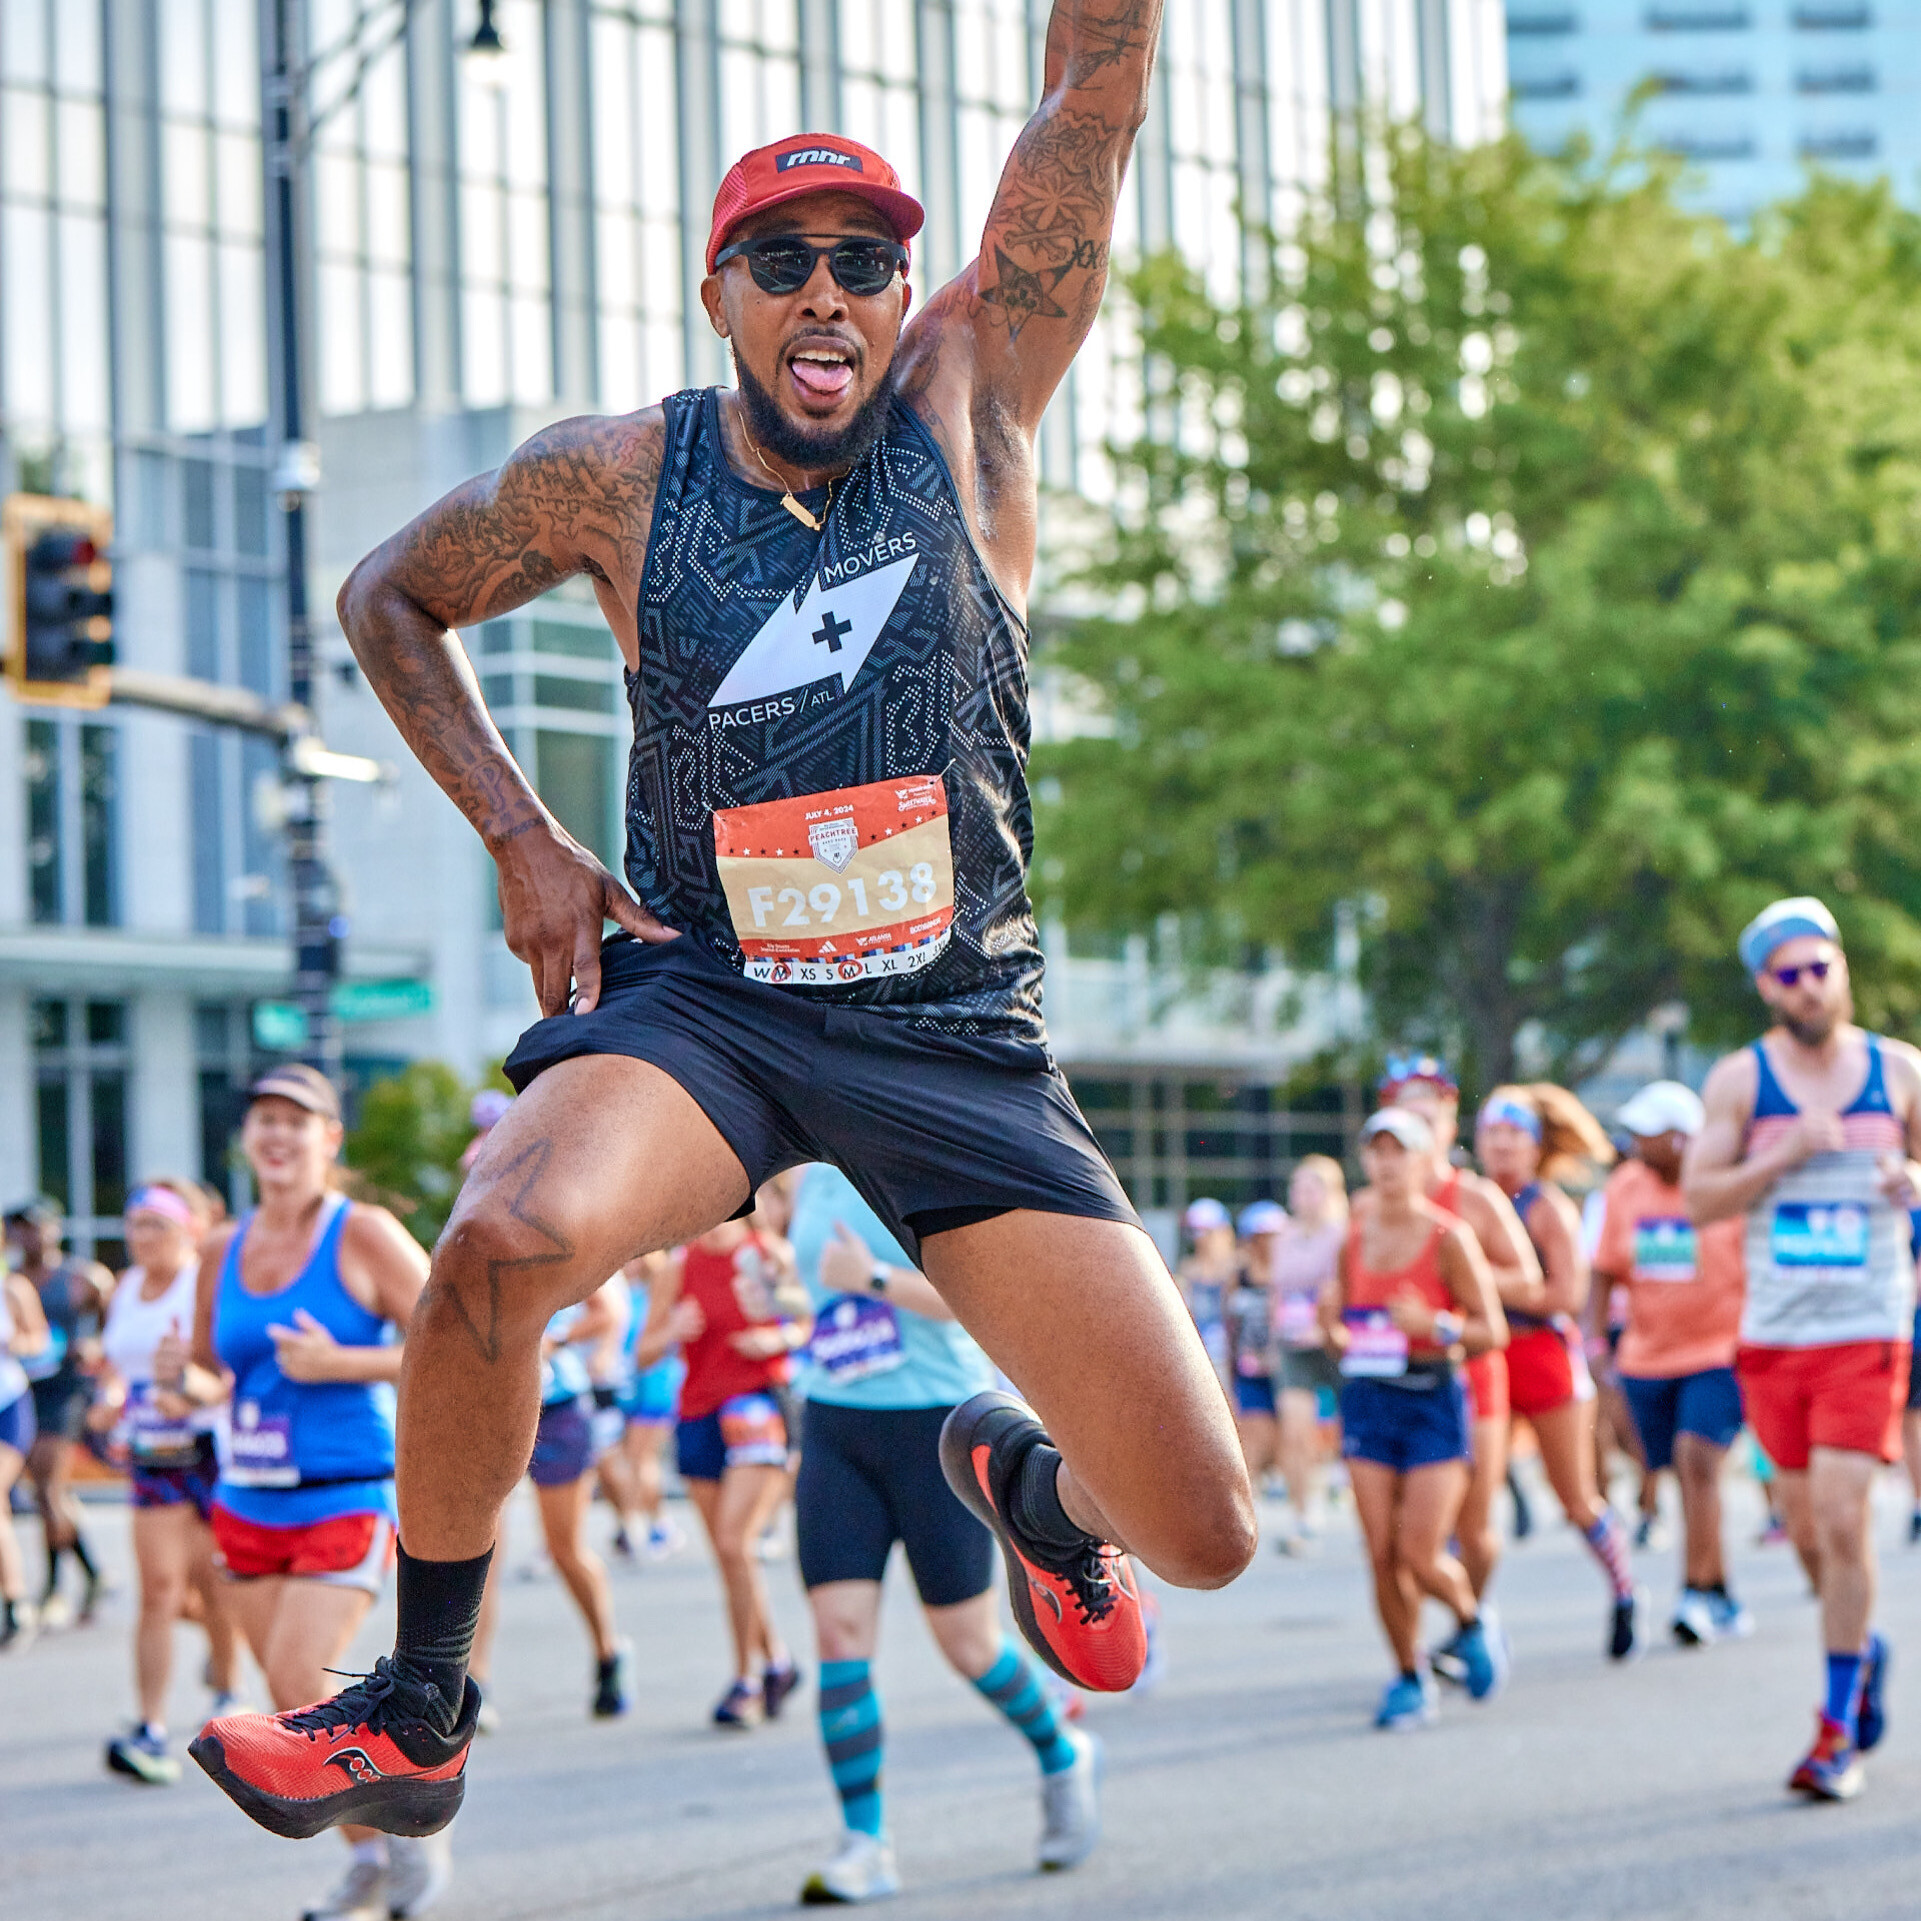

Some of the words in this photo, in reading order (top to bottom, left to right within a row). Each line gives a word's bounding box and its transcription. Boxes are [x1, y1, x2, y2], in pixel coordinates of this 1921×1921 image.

[786, 150, 851, 168] rnnr
[824, 531, 917, 583] MOVERS
[805, 810, 823, 820] JULY
[823, 808, 832, 817] 4,
[833, 804, 854, 816] 2024
[809, 828, 857, 842] PEACHTREE
[747, 862, 937, 928] F29138
[754, 967, 771, 979] W
[800, 968, 817, 981] XS
[826, 968, 834, 981] S
[843, 966, 856, 979] M
[864, 963, 873, 974] L
[882, 959, 898, 972] XL
